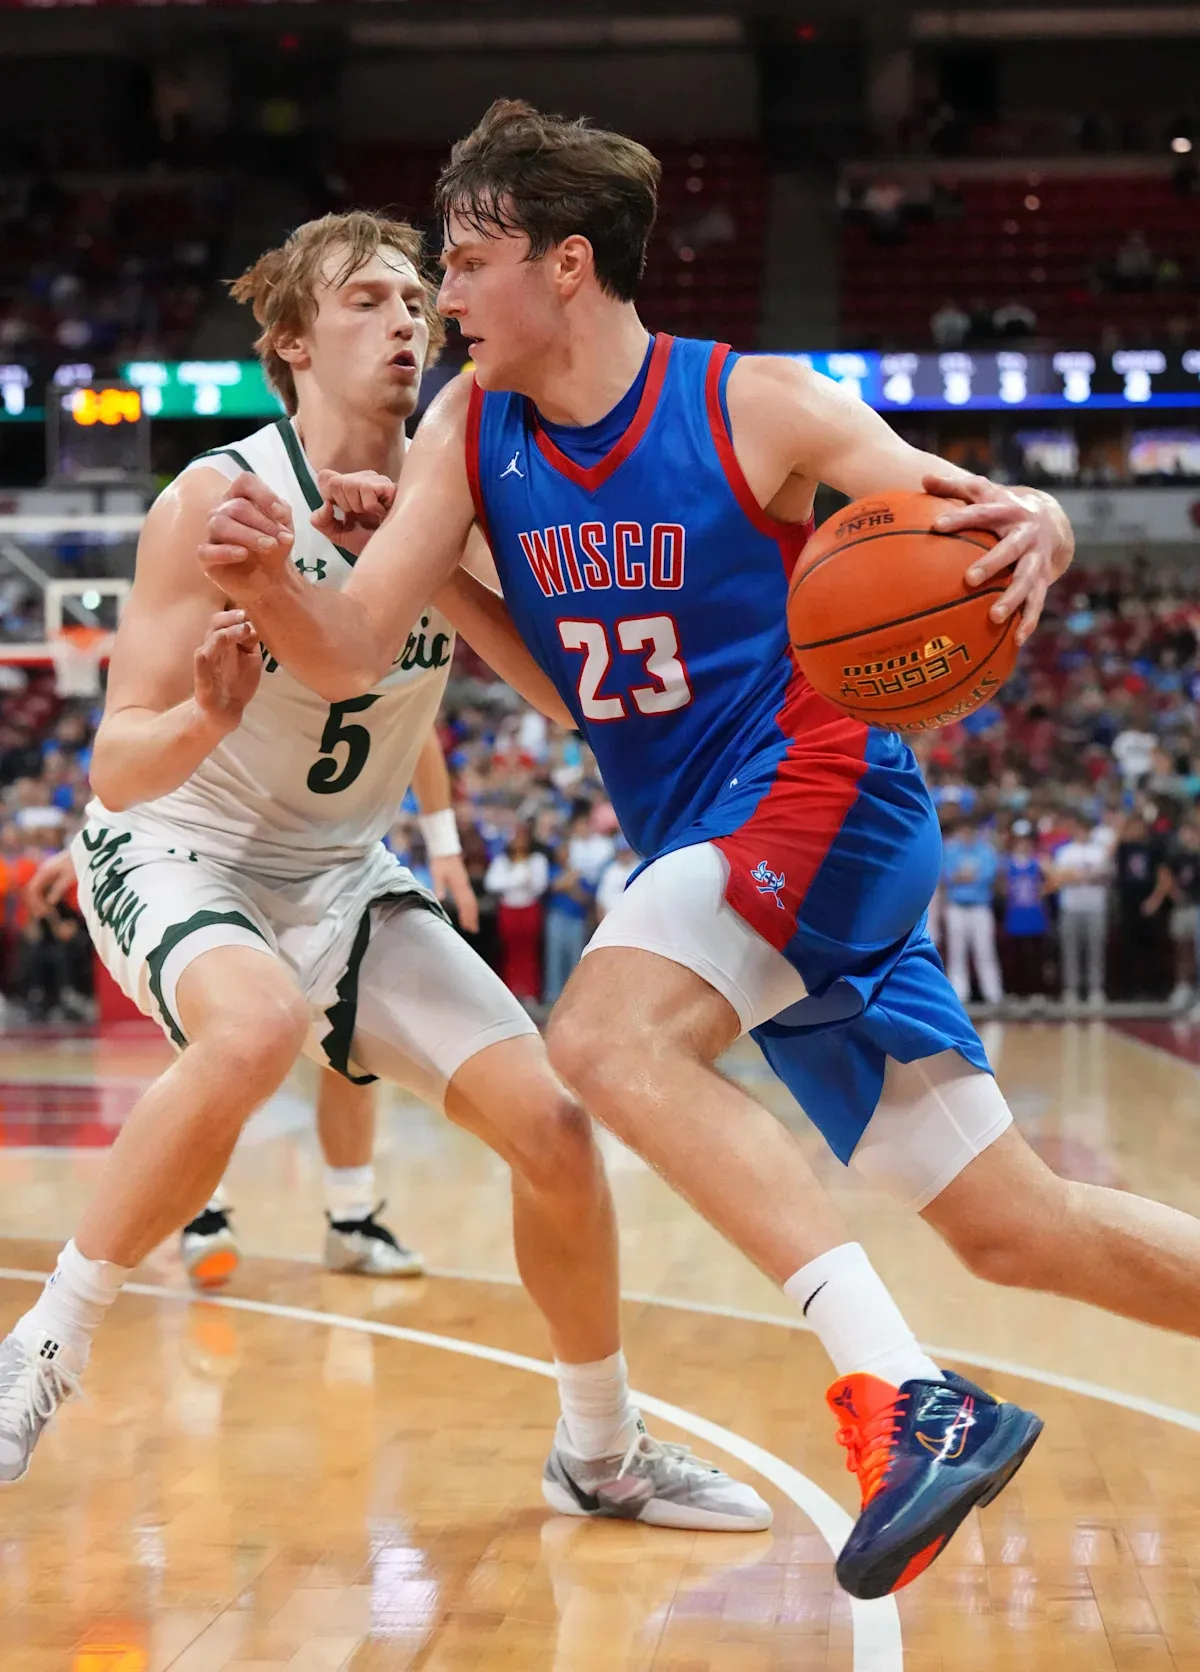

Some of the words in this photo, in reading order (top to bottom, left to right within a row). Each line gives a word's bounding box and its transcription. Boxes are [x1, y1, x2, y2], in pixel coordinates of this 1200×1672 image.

[847, 513, 895, 533] NFHS
[517, 520, 686, 598] WISCO
[556, 611, 694, 724] 23
[839, 643, 972, 698] LEGACY
[842, 649, 923, 678] 1000
[307, 693, 386, 795] 5
